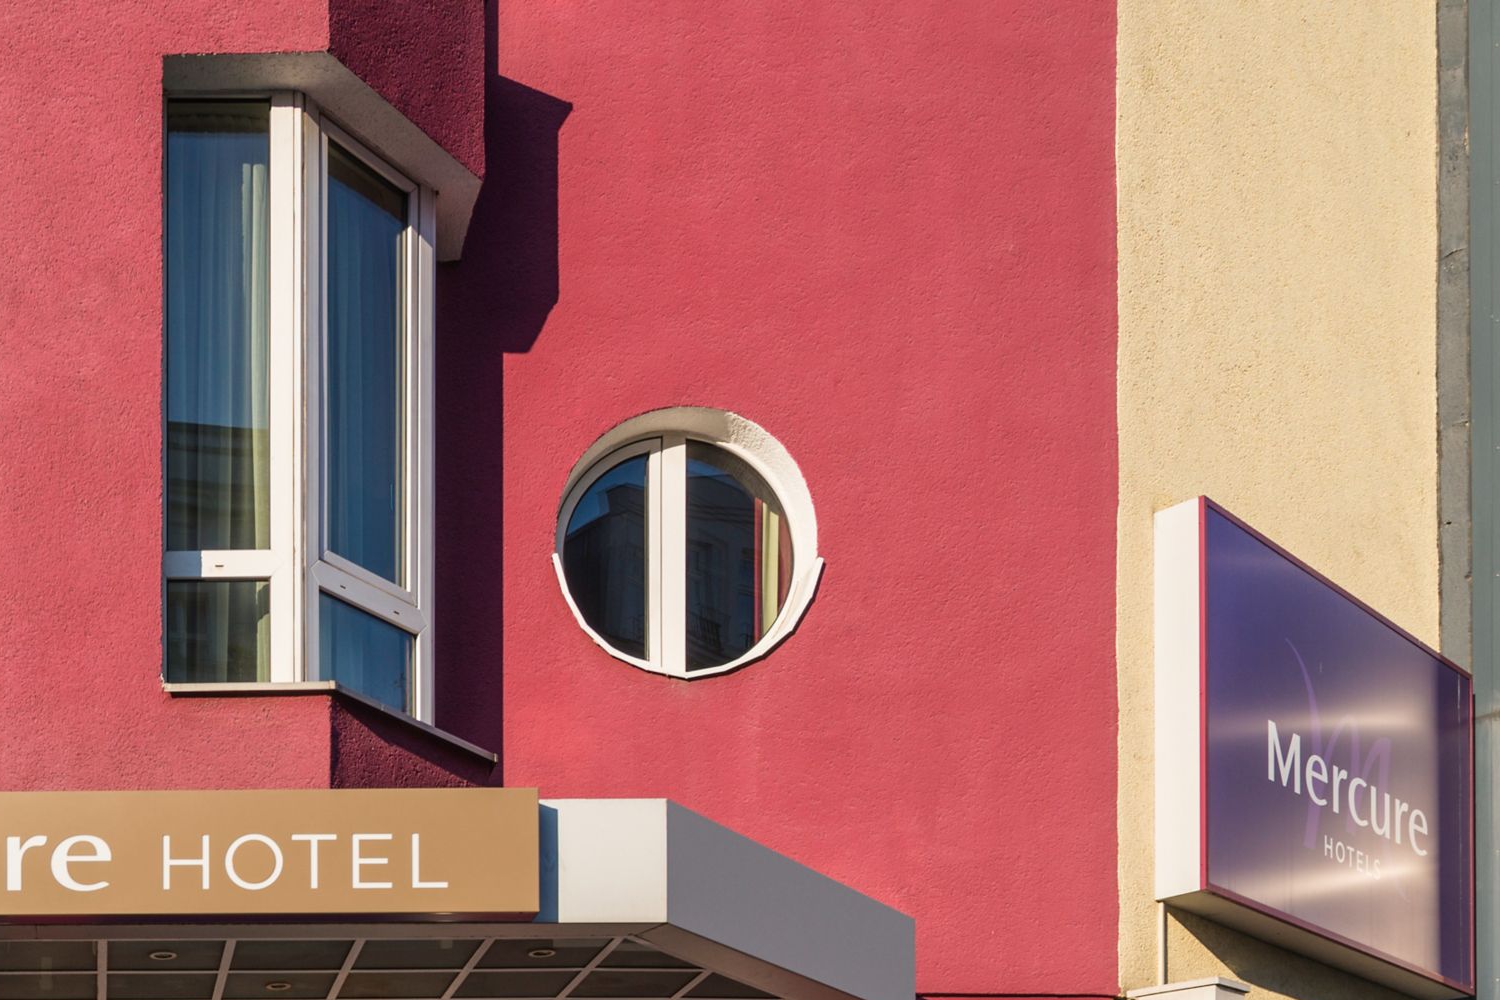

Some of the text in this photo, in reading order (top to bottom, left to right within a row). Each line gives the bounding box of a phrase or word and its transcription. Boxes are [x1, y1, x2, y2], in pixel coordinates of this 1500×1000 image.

[1268, 719, 1428, 856] Mercure
[161, 832, 449, 891] HOTEL
[1323, 835, 1381, 880] HOTELS
